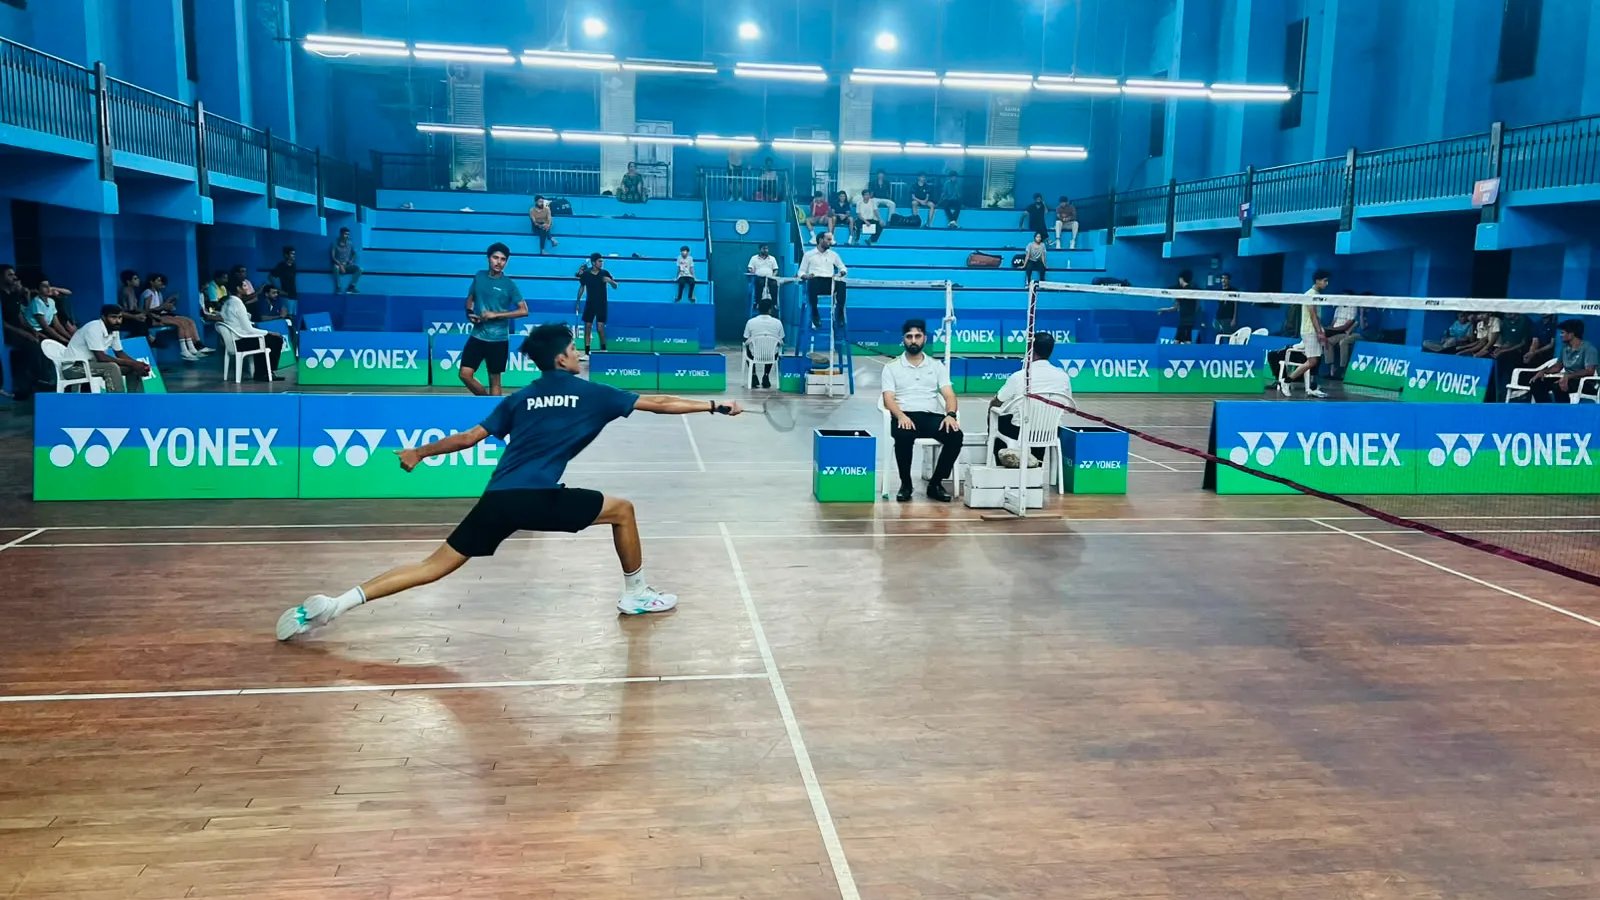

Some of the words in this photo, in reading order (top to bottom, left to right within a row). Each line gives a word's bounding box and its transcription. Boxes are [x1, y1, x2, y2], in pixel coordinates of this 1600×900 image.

[955, 330, 995, 342] YONEX
[349, 348, 418, 369] YONEX
[1373, 357, 1410, 378] YONEX
[619, 369, 641, 377] YONEX
[1090, 359, 1150, 378] YONEX
[1199, 359, 1255, 378] YONEX
[1435, 372, 1480, 397] YONEX
[527, 395, 579, 411] PANDIT
[140, 427, 279, 467] YONEX
[1296, 431, 1401, 467] YONEX
[1492, 432, 1593, 467] YONEX
[839, 466, 867, 475] YONEX
[1095, 460, 1121, 469] YONEX
